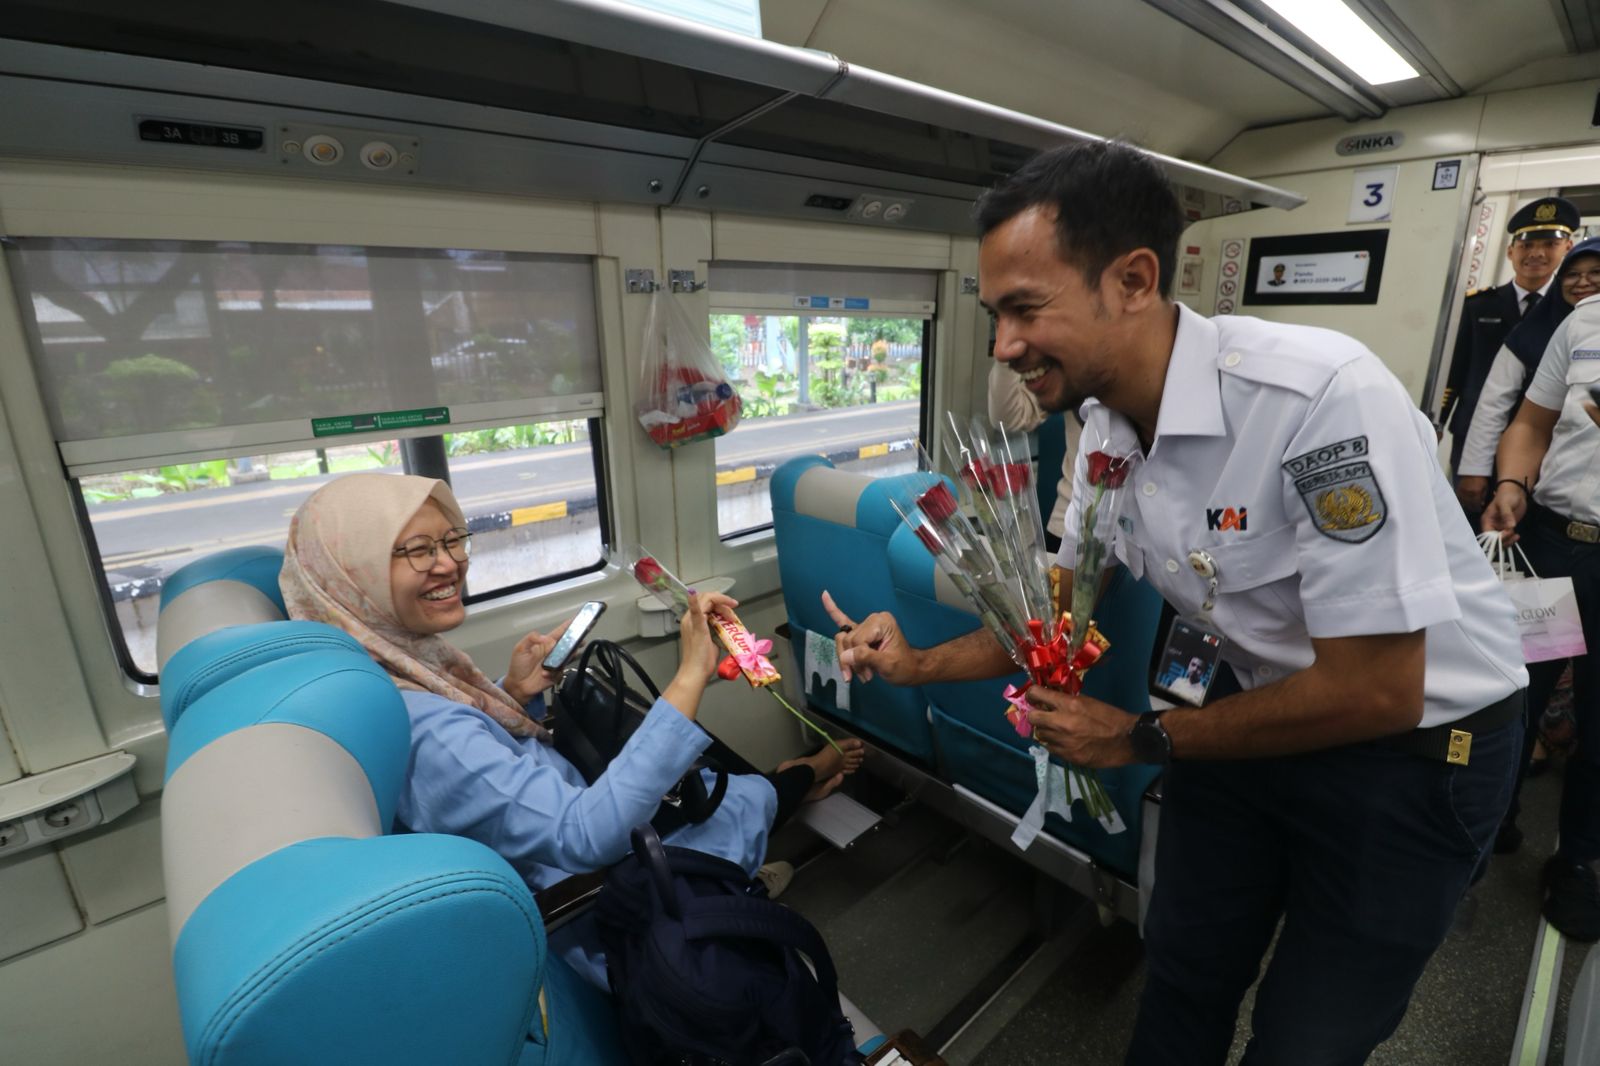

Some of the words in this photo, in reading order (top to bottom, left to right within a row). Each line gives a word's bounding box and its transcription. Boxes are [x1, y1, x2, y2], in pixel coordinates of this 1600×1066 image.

[162, 125, 182, 139] 3A
[222, 132, 240, 144] 3B
[1355, 135, 1394, 149] INKA
[1363, 182, 1384, 207] 3
[1290, 445, 1345, 474] DAOP
[1206, 506, 1248, 531] KAI
[1521, 607, 1556, 620] GLOW
[1202, 633, 1220, 647] KAI
